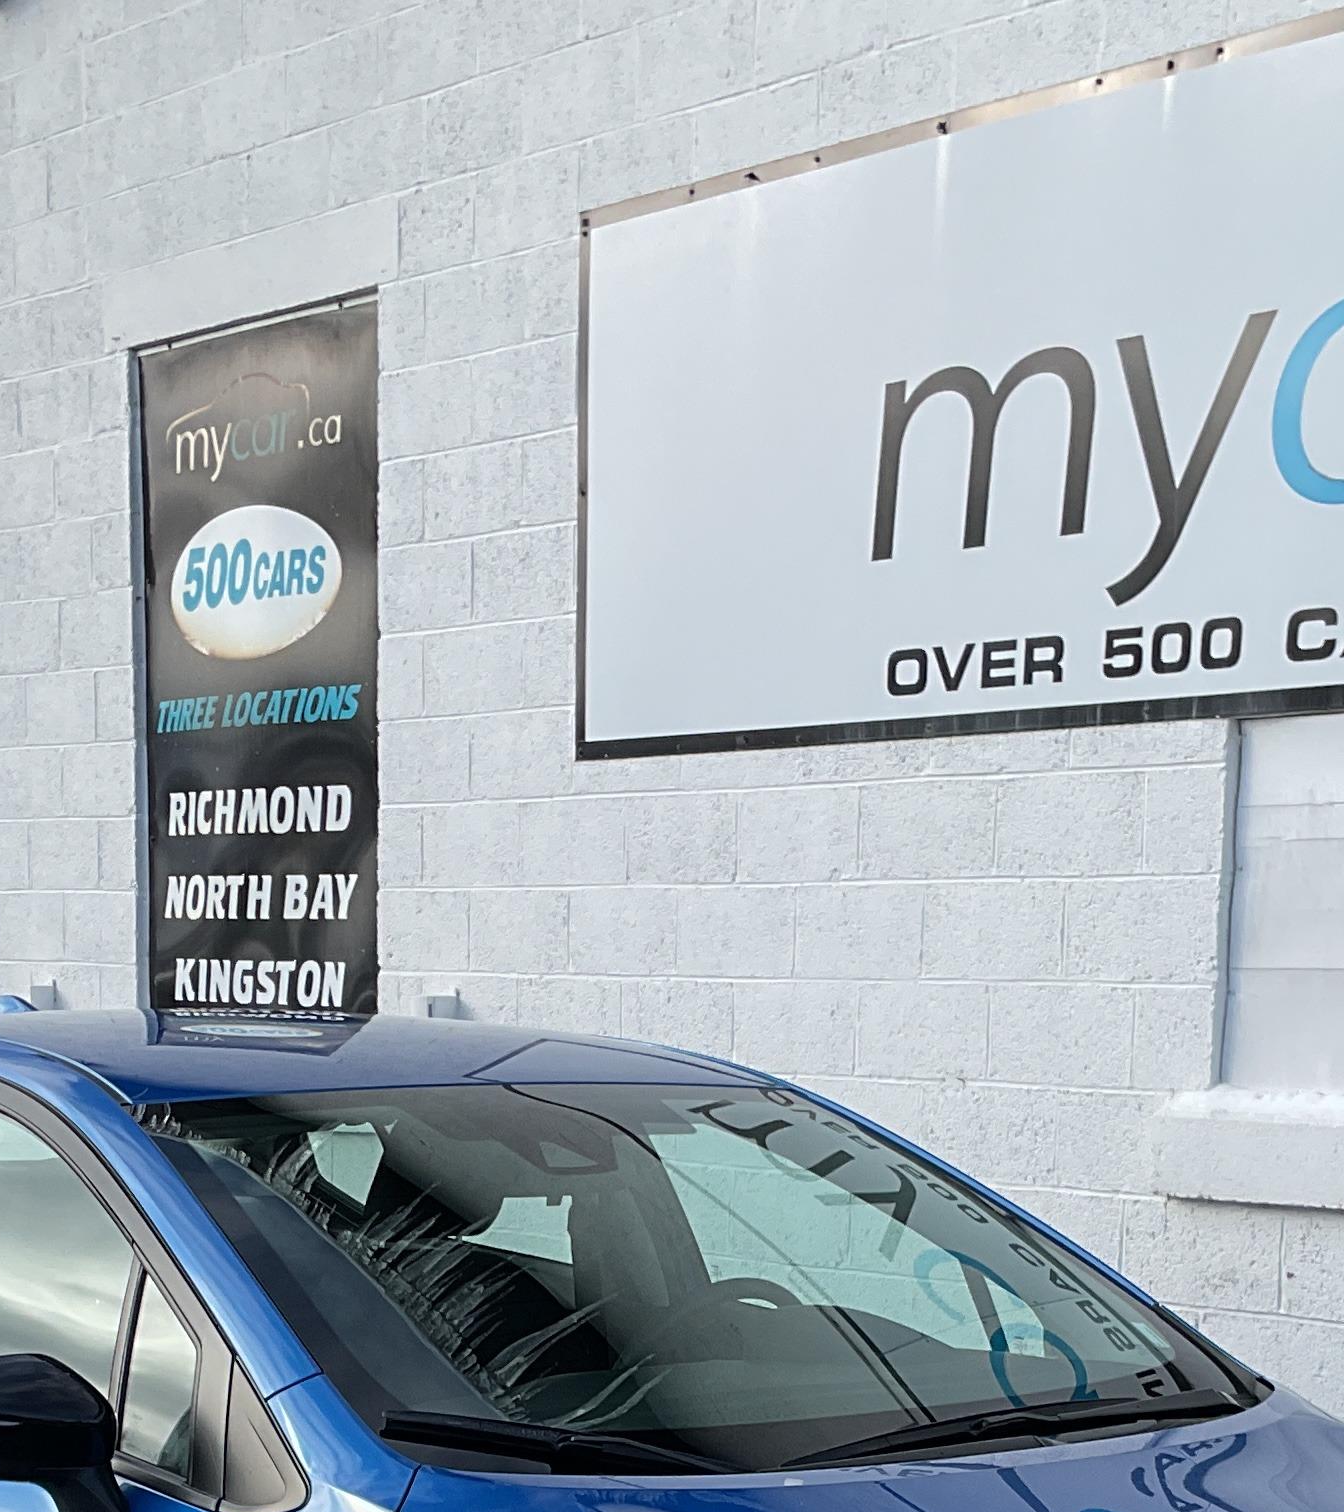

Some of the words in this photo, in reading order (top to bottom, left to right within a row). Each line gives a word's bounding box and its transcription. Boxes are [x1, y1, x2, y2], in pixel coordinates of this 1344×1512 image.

[886, 635, 1064, 696] OVER
[1103, 617, 1244, 678] 500
[157, 695, 219, 734] THREE
[221, 684, 362, 728] LOCATIONS
[168, 785, 353, 837] RICHMOND
[164, 874, 272, 920] NORTH
[283, 874, 358, 920] BAY
[174, 958, 347, 1008] KINGSTON
